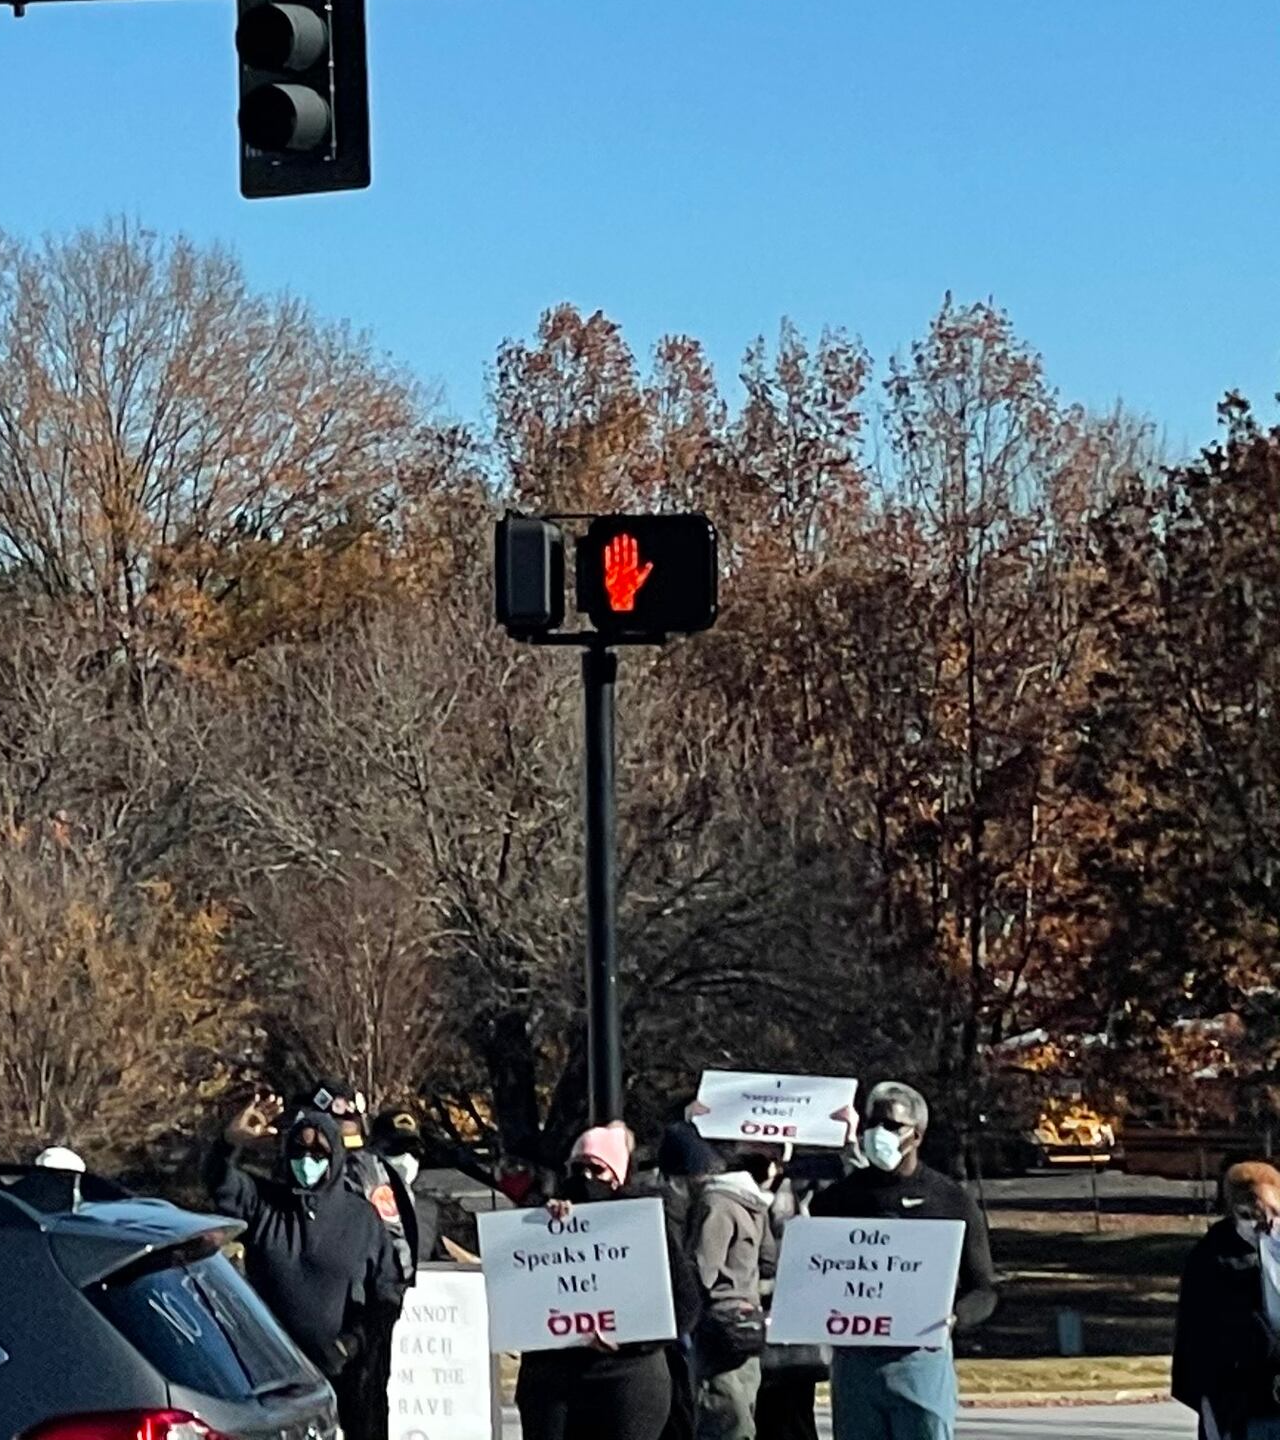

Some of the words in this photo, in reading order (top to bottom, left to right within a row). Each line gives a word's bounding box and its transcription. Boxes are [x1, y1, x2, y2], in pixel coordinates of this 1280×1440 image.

[740, 1121, 798, 1138] ODE
[547, 1216, 590, 1235] Ode
[849, 1228, 891, 1246] Ode
[512, 1246, 586, 1272] Speaks
[594, 1243, 631, 1262] For
[808, 1254, 879, 1276] Speaks
[887, 1256, 924, 1273] For
[557, 1273, 599, 1295] Me!
[843, 1281, 884, 1300] Me!
[403, 1305, 458, 1324] NNOT
[547, 1310, 617, 1336] ODE
[826, 1313, 894, 1337] ODE
[399, 1336, 453, 1355] EACH
[398, 1398, 454, 1416] RAVE
